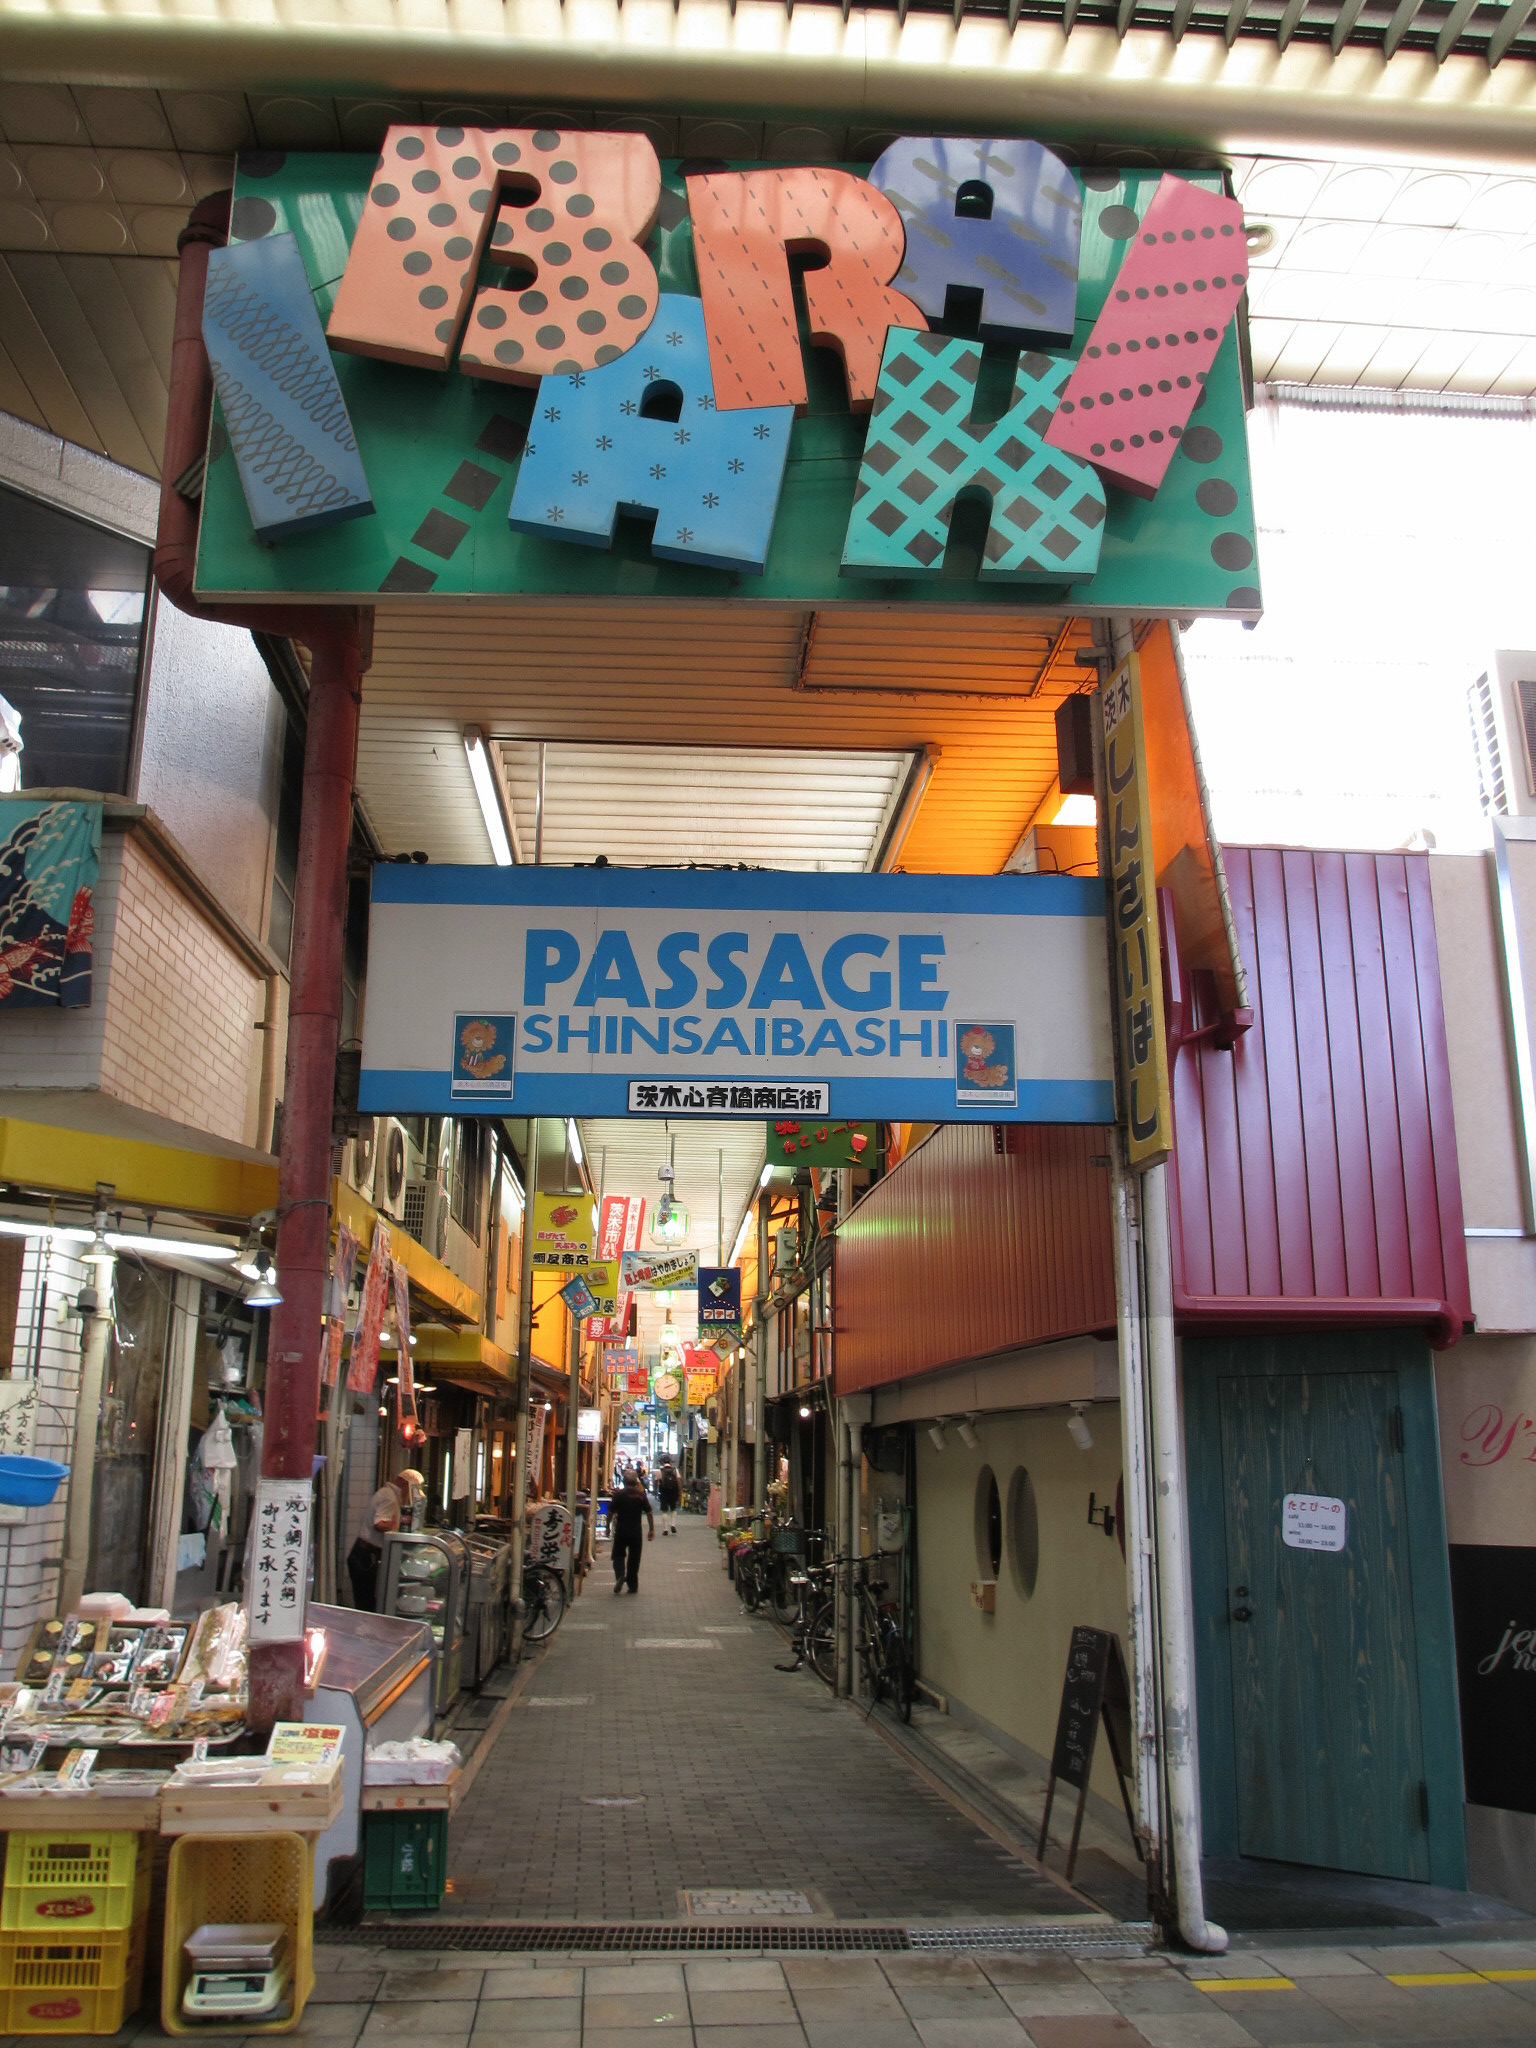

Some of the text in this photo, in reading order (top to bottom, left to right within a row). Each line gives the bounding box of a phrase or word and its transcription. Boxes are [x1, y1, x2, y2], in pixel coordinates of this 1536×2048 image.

[1104, 674, 1130, 733] 茨木
[523, 929, 949, 1012] PASSAGE
[1107, 736, 1159, 1144] しんさいばし
[521, 1014, 948, 1059] SHINSAIBASHI
